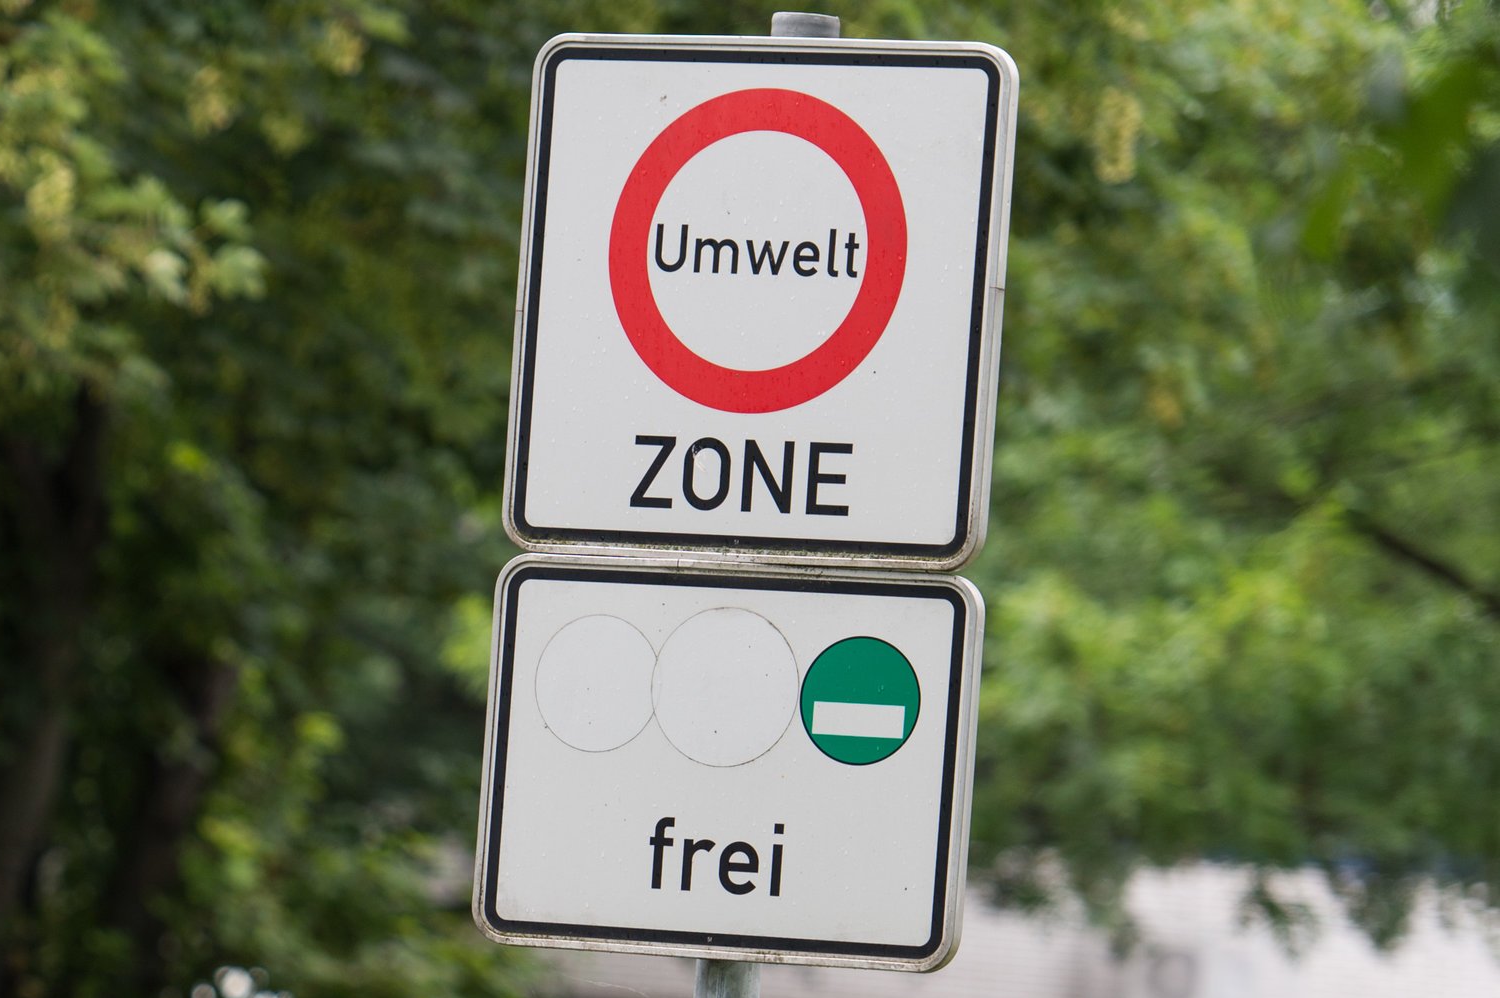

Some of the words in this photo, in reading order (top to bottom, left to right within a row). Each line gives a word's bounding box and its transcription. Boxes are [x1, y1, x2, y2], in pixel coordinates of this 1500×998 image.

[654, 223, 860, 279] Umwelt
[630, 434, 854, 518] ZONE
[649, 816, 785, 897] frei
